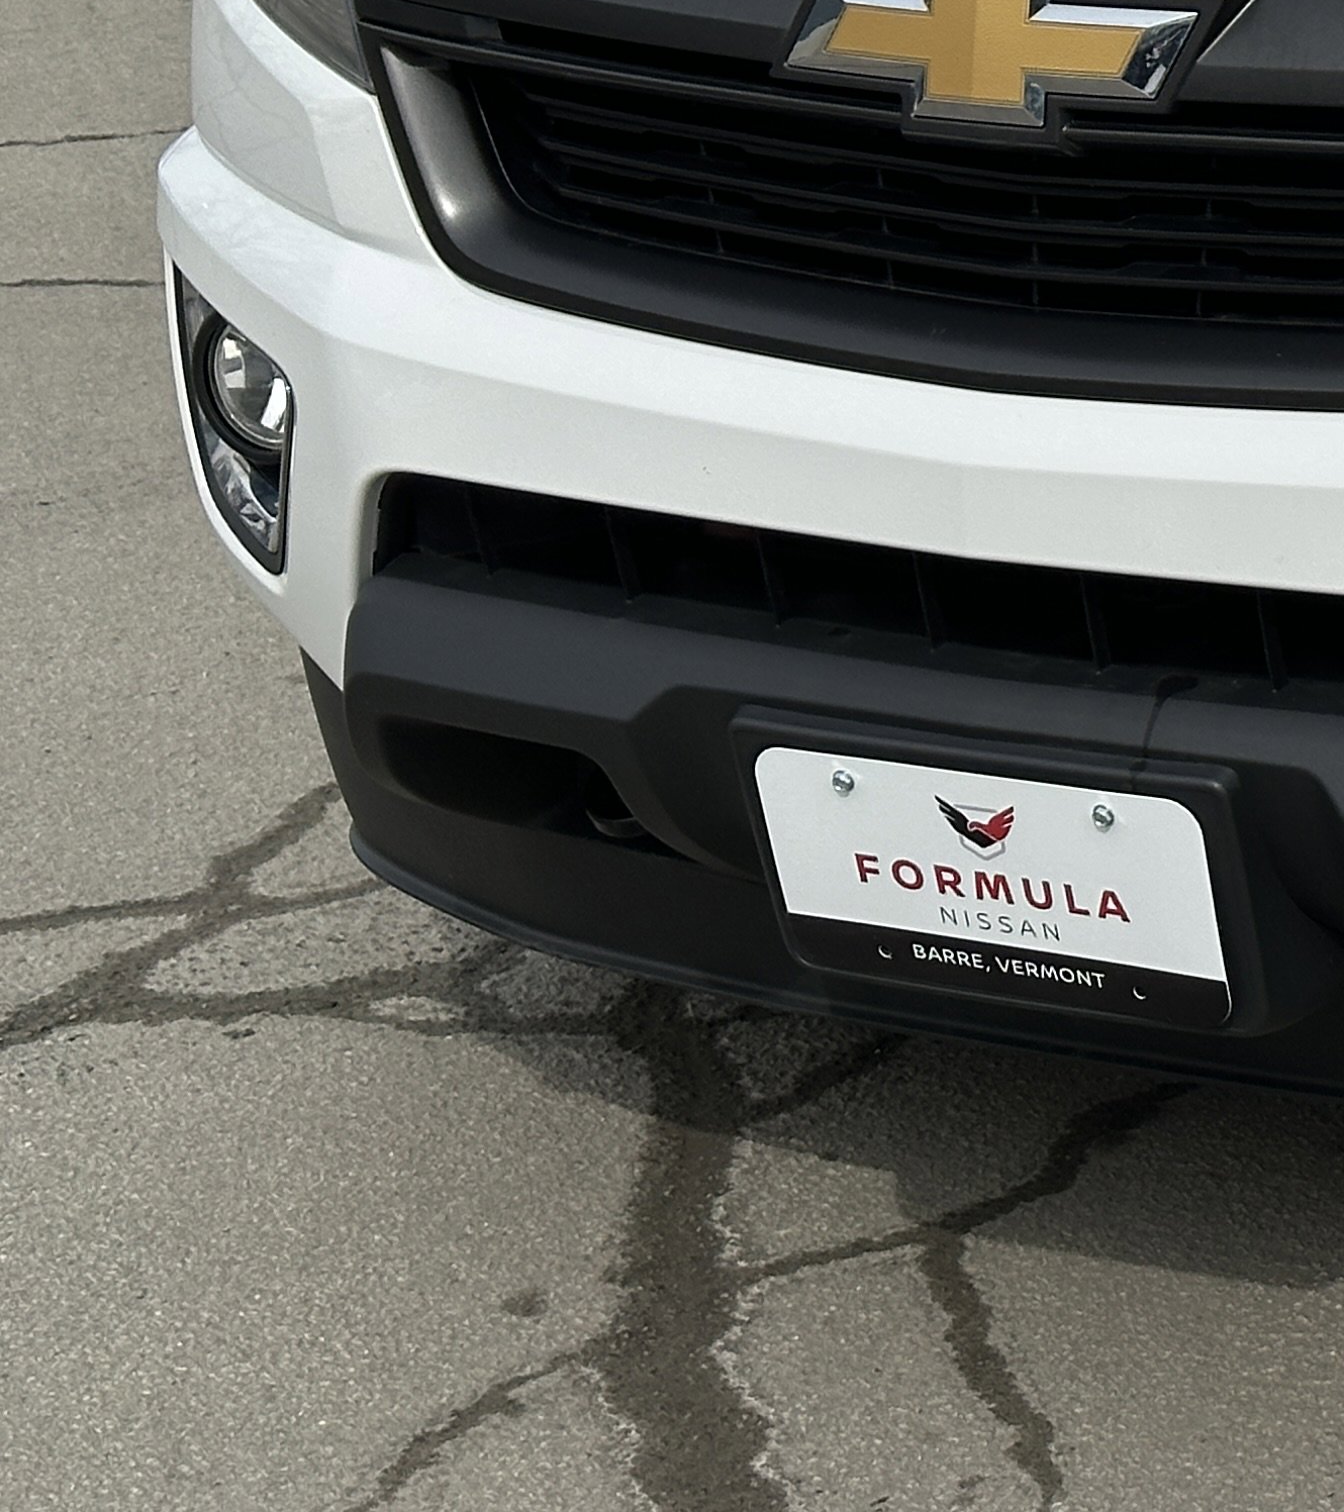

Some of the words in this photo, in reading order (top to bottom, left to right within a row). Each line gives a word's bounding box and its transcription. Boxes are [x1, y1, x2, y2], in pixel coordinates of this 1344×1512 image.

[853, 852, 1131, 923] FORMULA
[940, 905, 1061, 942] NISSAN
[911, 943, 991, 974] BARRE,
[994, 955, 1106, 989] VERMONT
